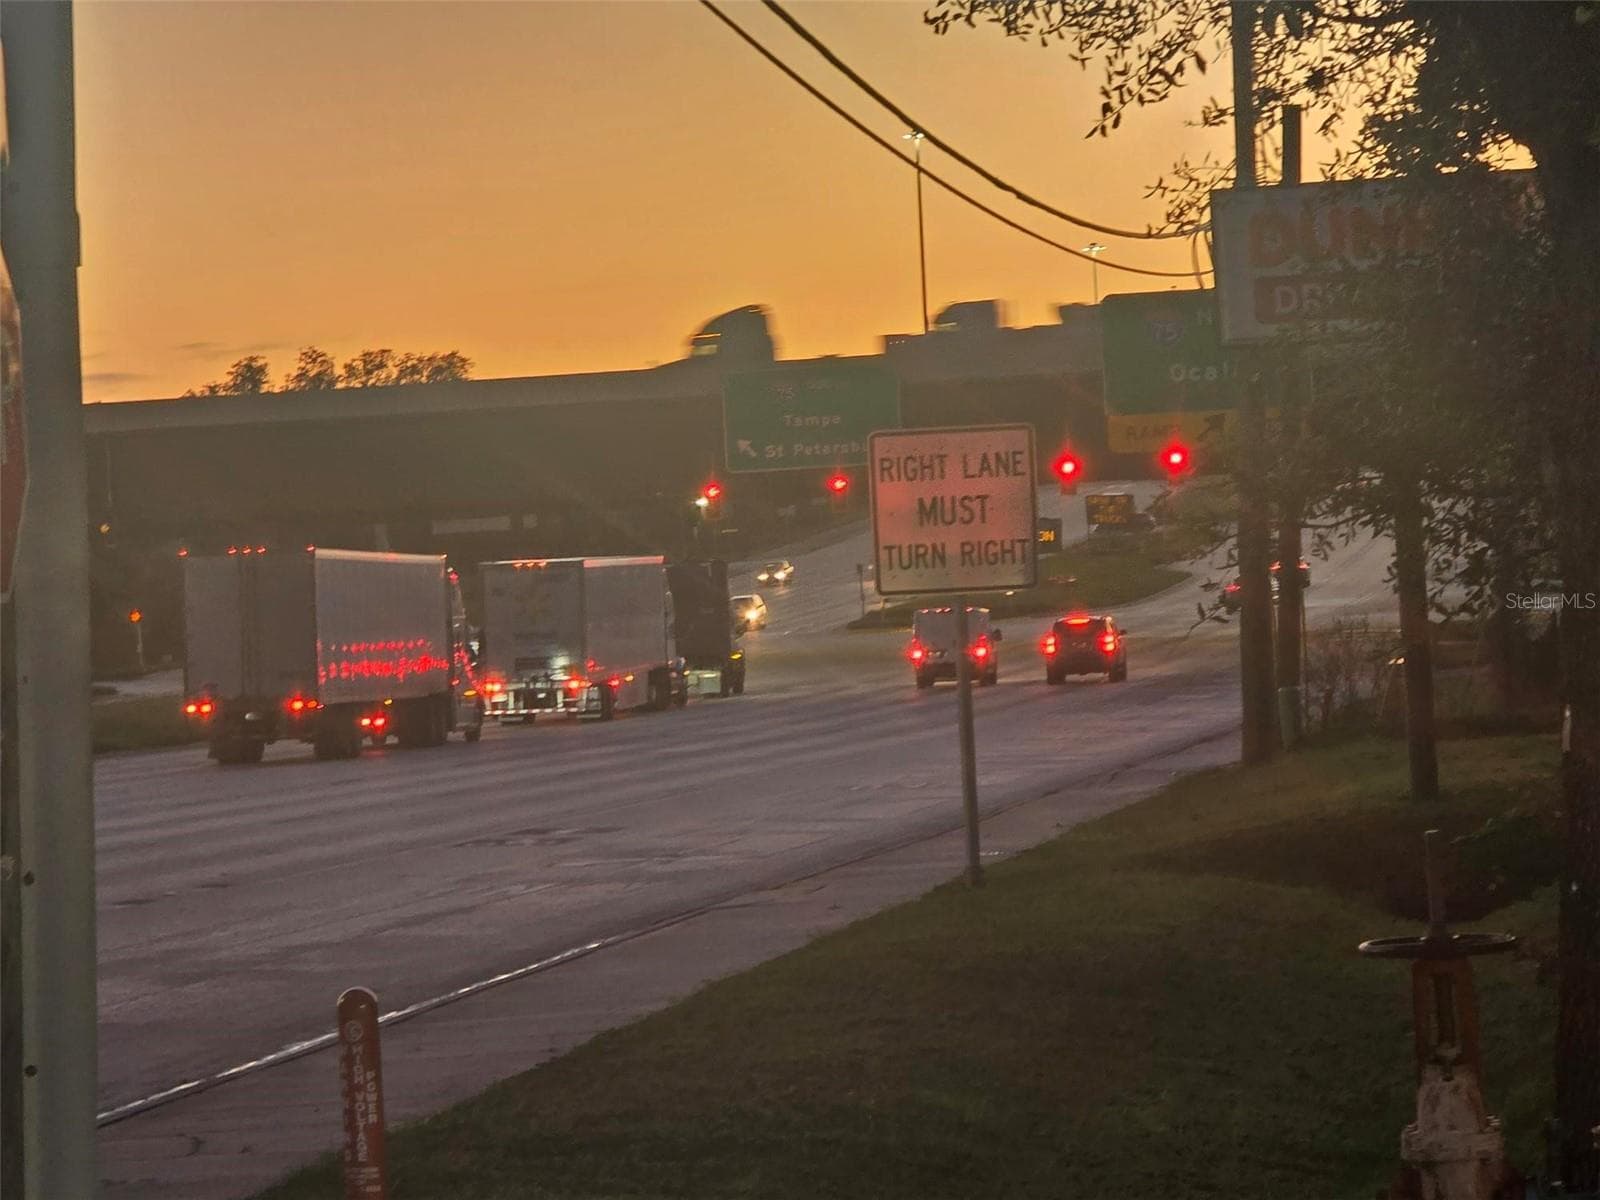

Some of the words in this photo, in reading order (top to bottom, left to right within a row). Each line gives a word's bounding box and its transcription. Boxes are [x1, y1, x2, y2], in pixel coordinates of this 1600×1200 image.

[783, 414, 841, 429] Tampa
[879, 453, 948, 482] RIGHT
[962, 449, 1026, 479] LANE
[917, 494, 990, 527] MUST
[883, 541, 947, 571] TURN
[960, 538, 1029, 567] RIGHT
[365, 1070, 378, 1125] POWER
